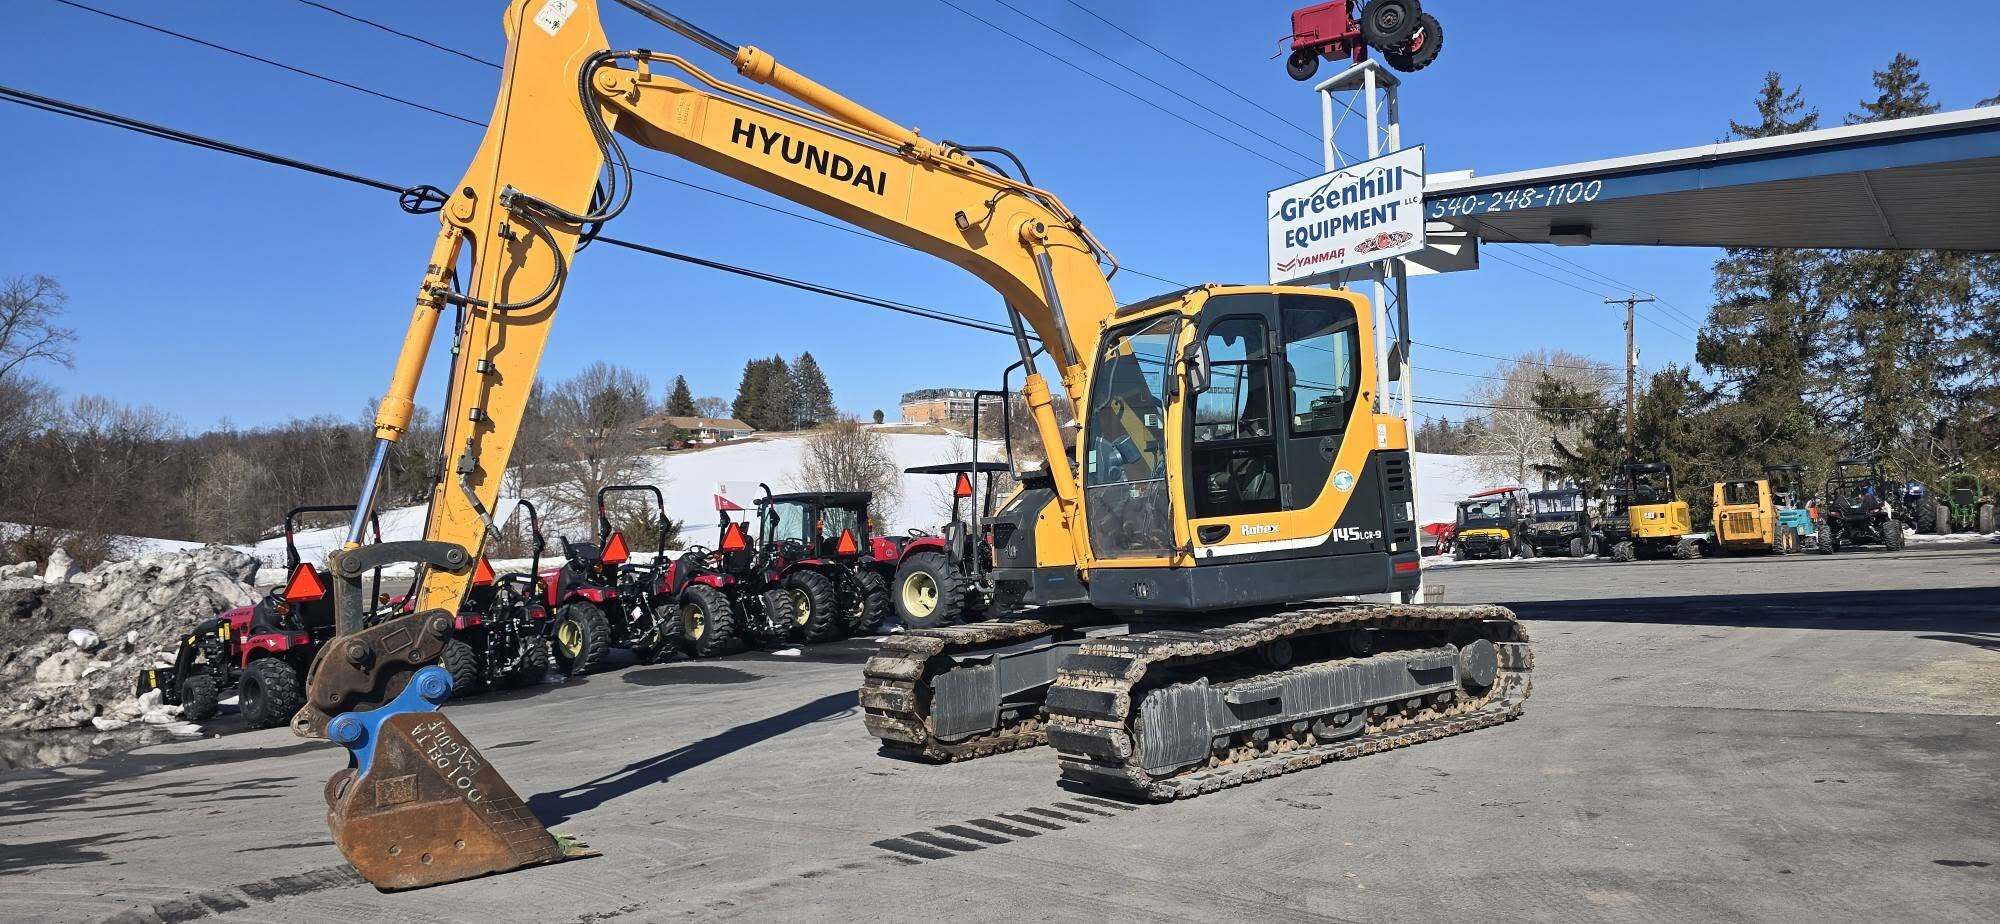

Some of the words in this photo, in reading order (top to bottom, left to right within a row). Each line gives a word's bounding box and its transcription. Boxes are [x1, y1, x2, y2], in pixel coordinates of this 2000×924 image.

[731, 117, 887, 196] HYUNDAI
[1280, 165, 1402, 222] Greenhill
[1432, 180, 1602, 218] 540-248-1100
[1285, 200, 1401, 249] EQUIPMENT
[1404, 196, 1418, 206] LLC
[1295, 247, 1346, 268] YANMAR
[411, 722, 451, 769] DELTA
